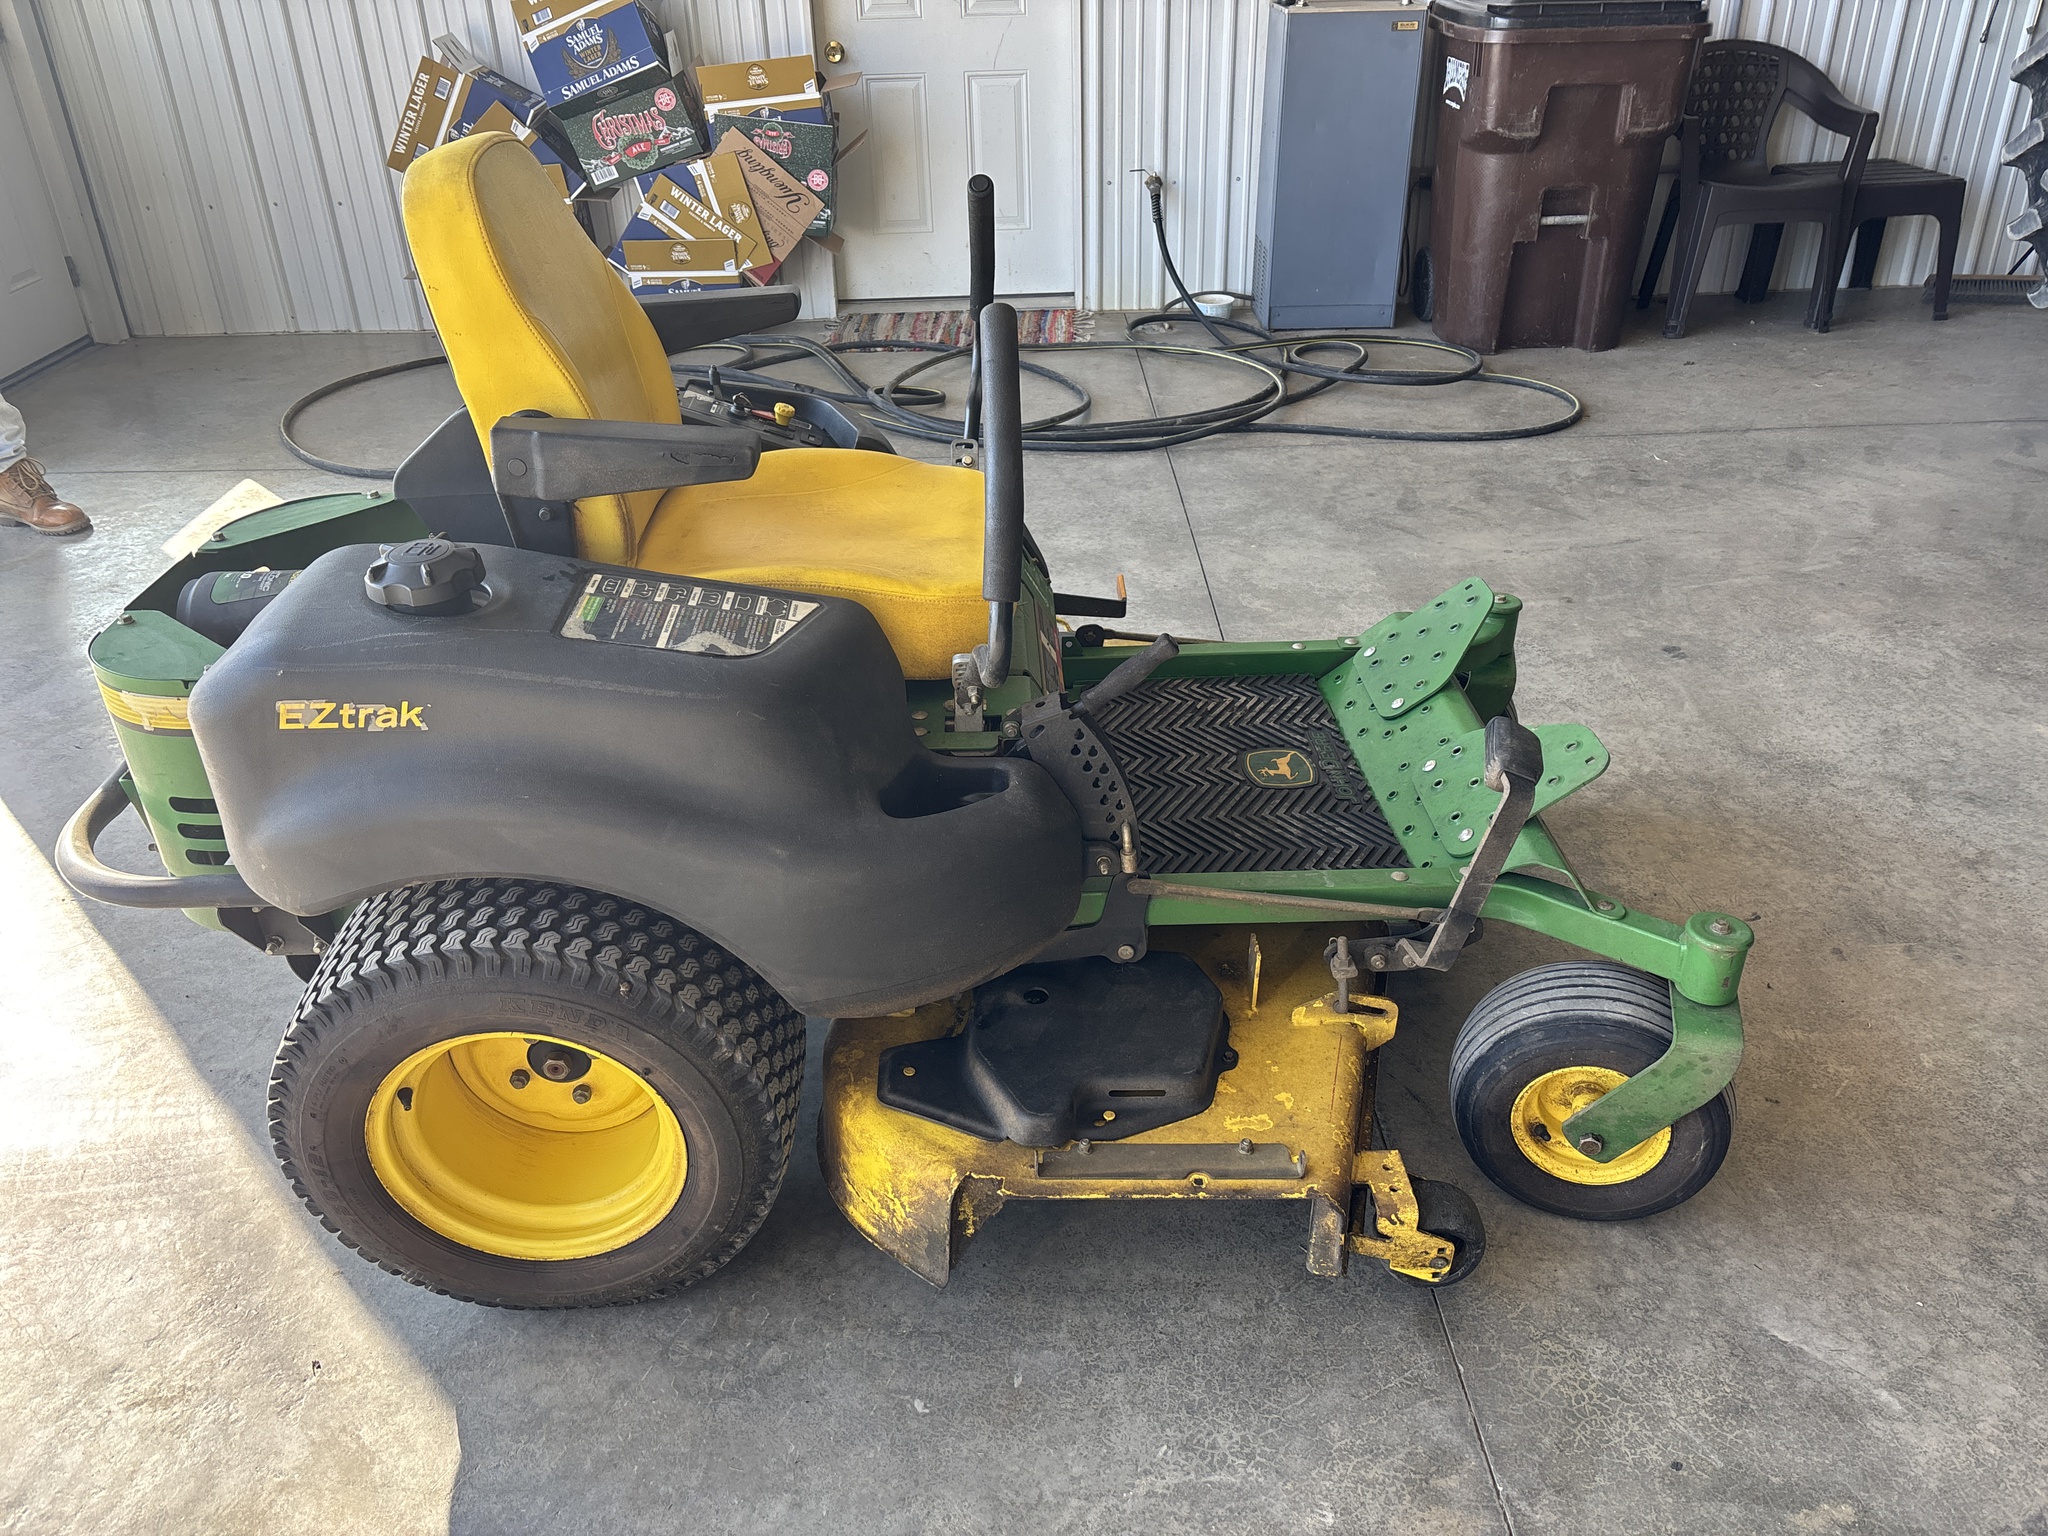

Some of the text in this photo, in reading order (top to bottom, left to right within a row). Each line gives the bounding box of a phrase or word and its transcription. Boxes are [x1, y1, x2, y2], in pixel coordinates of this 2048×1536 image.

[566, 24, 603, 48] SAMUEL
[573, 34, 603, 55] ADAMS
[579, 45, 602, 57] WINTER
[583, 52, 602, 63] LAGER
[561, 74, 602, 100] SAMUEL
[602, 56, 640, 80] ADAMS
[394, 72, 430, 155] WINTER LAGER
[592, 107, 666, 150] CHRISTMAS
[631, 142, 647, 154] ALE
[738, 149, 810, 214] Yuengling
[670, 185, 710, 220] WINTER
[708, 216, 742, 244] LAGER
[279, 701, 424, 730] EZtrak
[1325, 769, 1361, 805] JOHN
[499, 998, 630, 1042] KENDA
